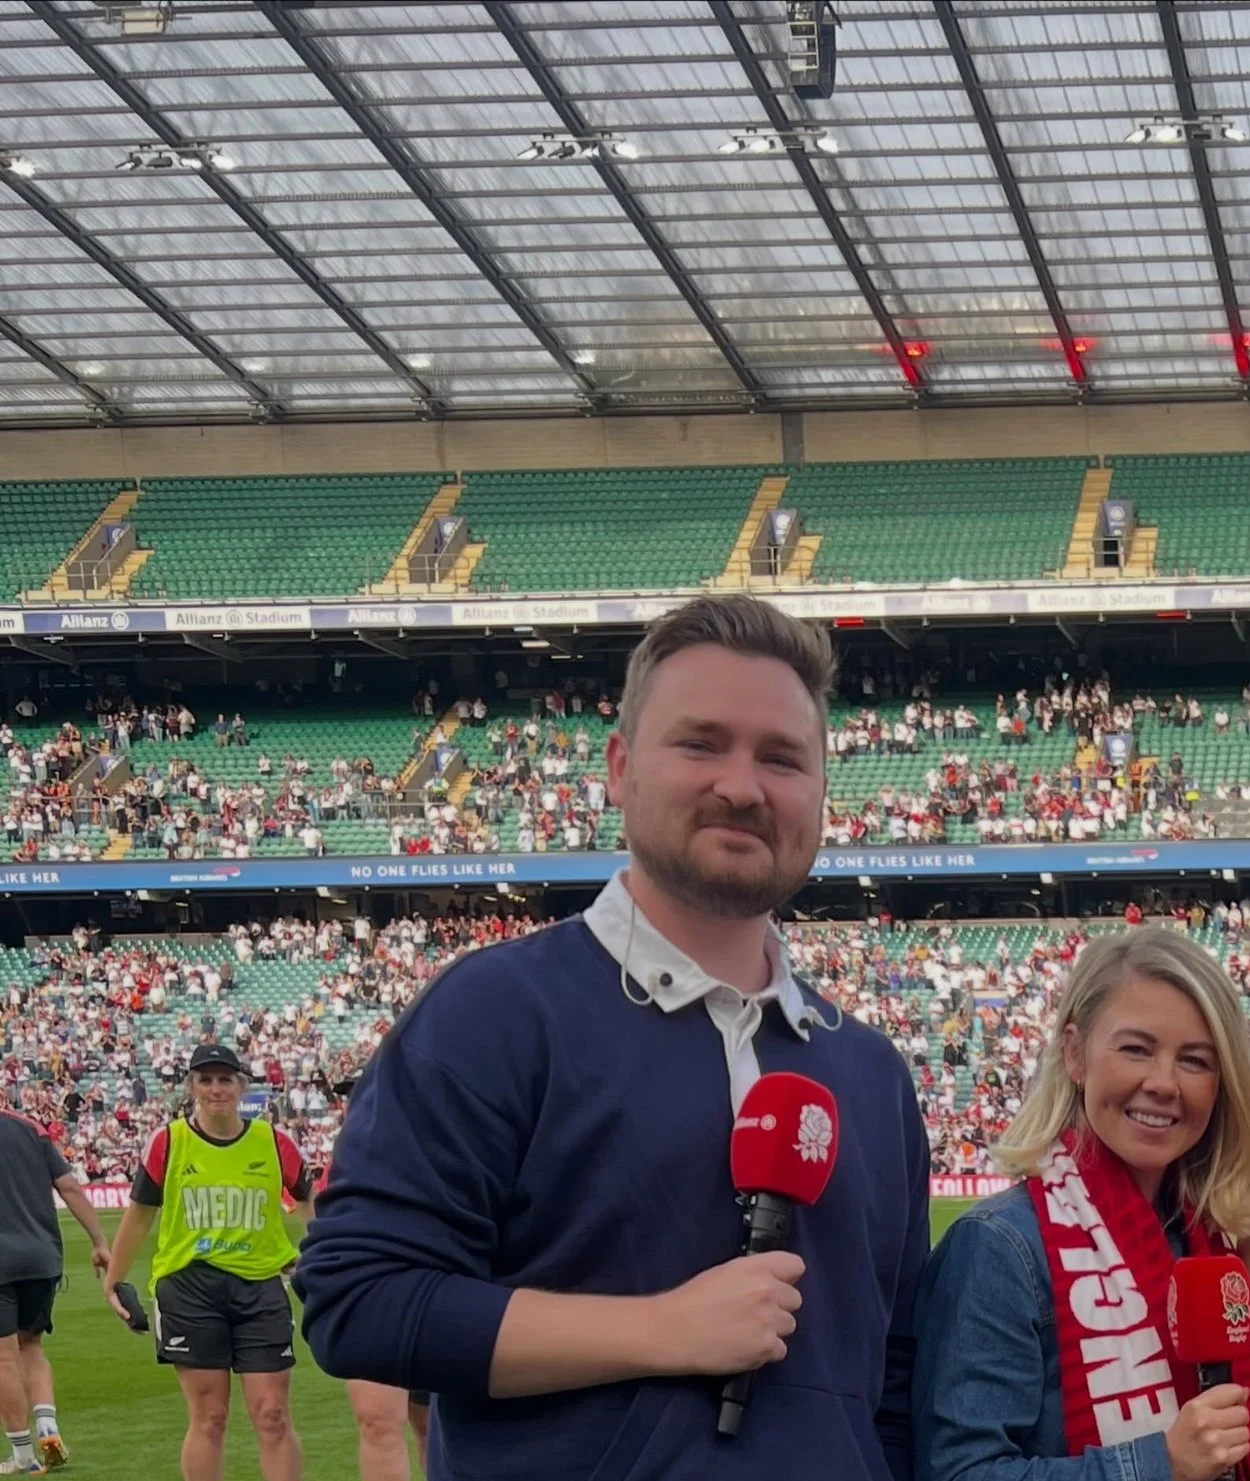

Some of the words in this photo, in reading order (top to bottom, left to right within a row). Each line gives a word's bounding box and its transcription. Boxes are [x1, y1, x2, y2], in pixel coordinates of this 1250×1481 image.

[1110, 592, 1165, 604] Stadium
[176, 612, 222, 625] Allianz
[246, 611, 302, 624] Stadium
[348, 608, 396, 624] Allianz
[462, 606, 507, 620] Allianz
[533, 606, 589, 619] Stadium
[61, 614, 108, 629] Allianz
[835, 856, 865, 868] ONE
[870, 856, 907, 868] FLIES
[912, 855, 945, 867] LIKE
[948, 854, 976, 866] HER
[351, 866, 372, 878] NO
[377, 865, 406, 877] ONE
[412, 864, 448, 876] FLIES
[453, 864, 484, 876] LIKE
[489, 863, 516, 875] HER
[32, 872, 60, 884] HER
[183, 1186, 269, 1232] MEDIC
